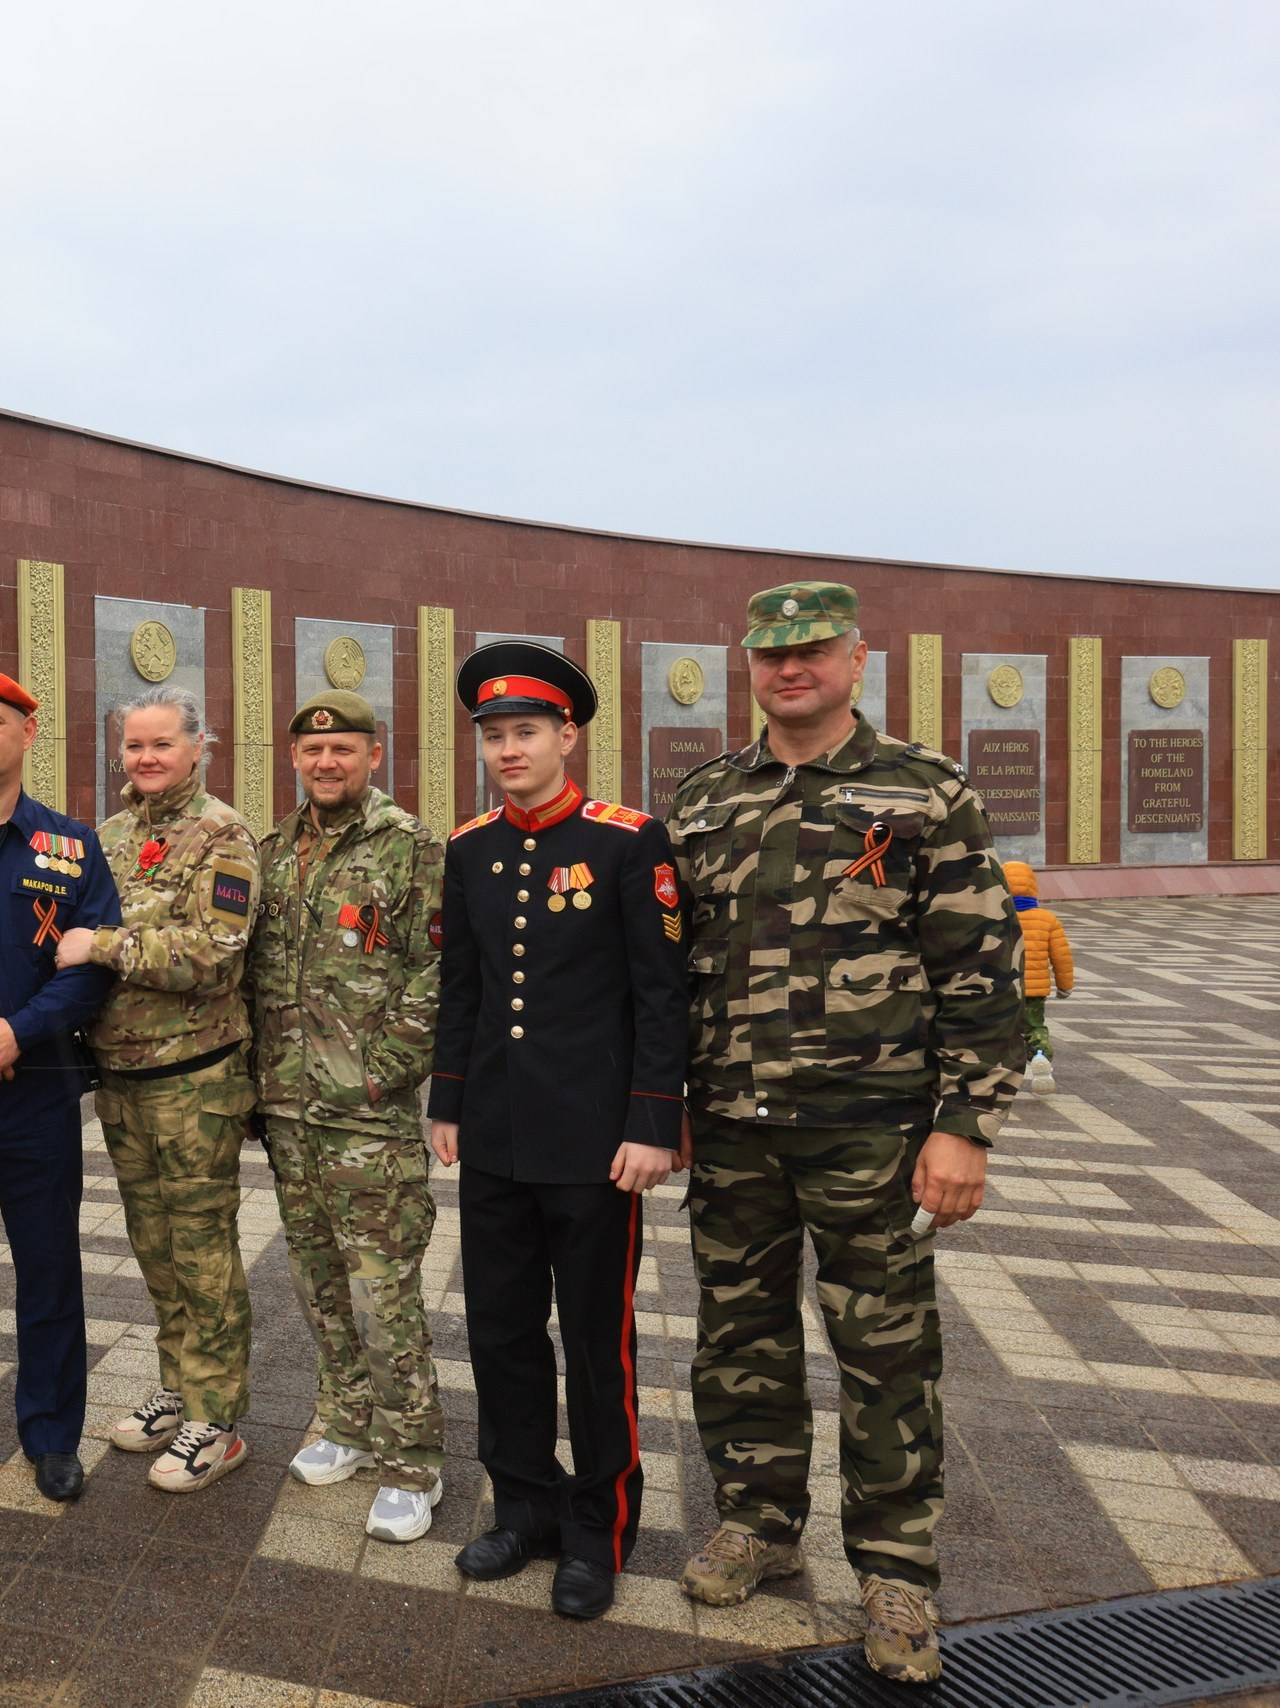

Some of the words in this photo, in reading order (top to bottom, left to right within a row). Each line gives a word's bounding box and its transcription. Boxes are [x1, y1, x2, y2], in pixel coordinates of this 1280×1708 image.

[670, 741, 705, 753] ISAMAA
[982, 742, 1001, 753] AUX
[1133, 739, 1147, 748] TO
[1149, 738, 1168, 748] THE
[1170, 738, 1203, 748] HEROES
[1150, 753, 1163, 763] OF
[1166, 753, 1185, 763] THE
[976, 765, 989, 776] DE
[991, 765, 1003, 776] LA
[1005, 765, 1034, 776] PATRIE
[1141, 767, 1193, 778] HOMELAND
[1154, 782, 1181, 793] FROM
[986, 788, 1041, 799] DESCENDANTS
[1142, 798, 1191, 809] GRATEFUL
[1135, 813, 1201, 824] DESCENDANTS
[22, 878, 54, 893] МАКАРОВ
[216, 884, 246, 903] МАТЬ
